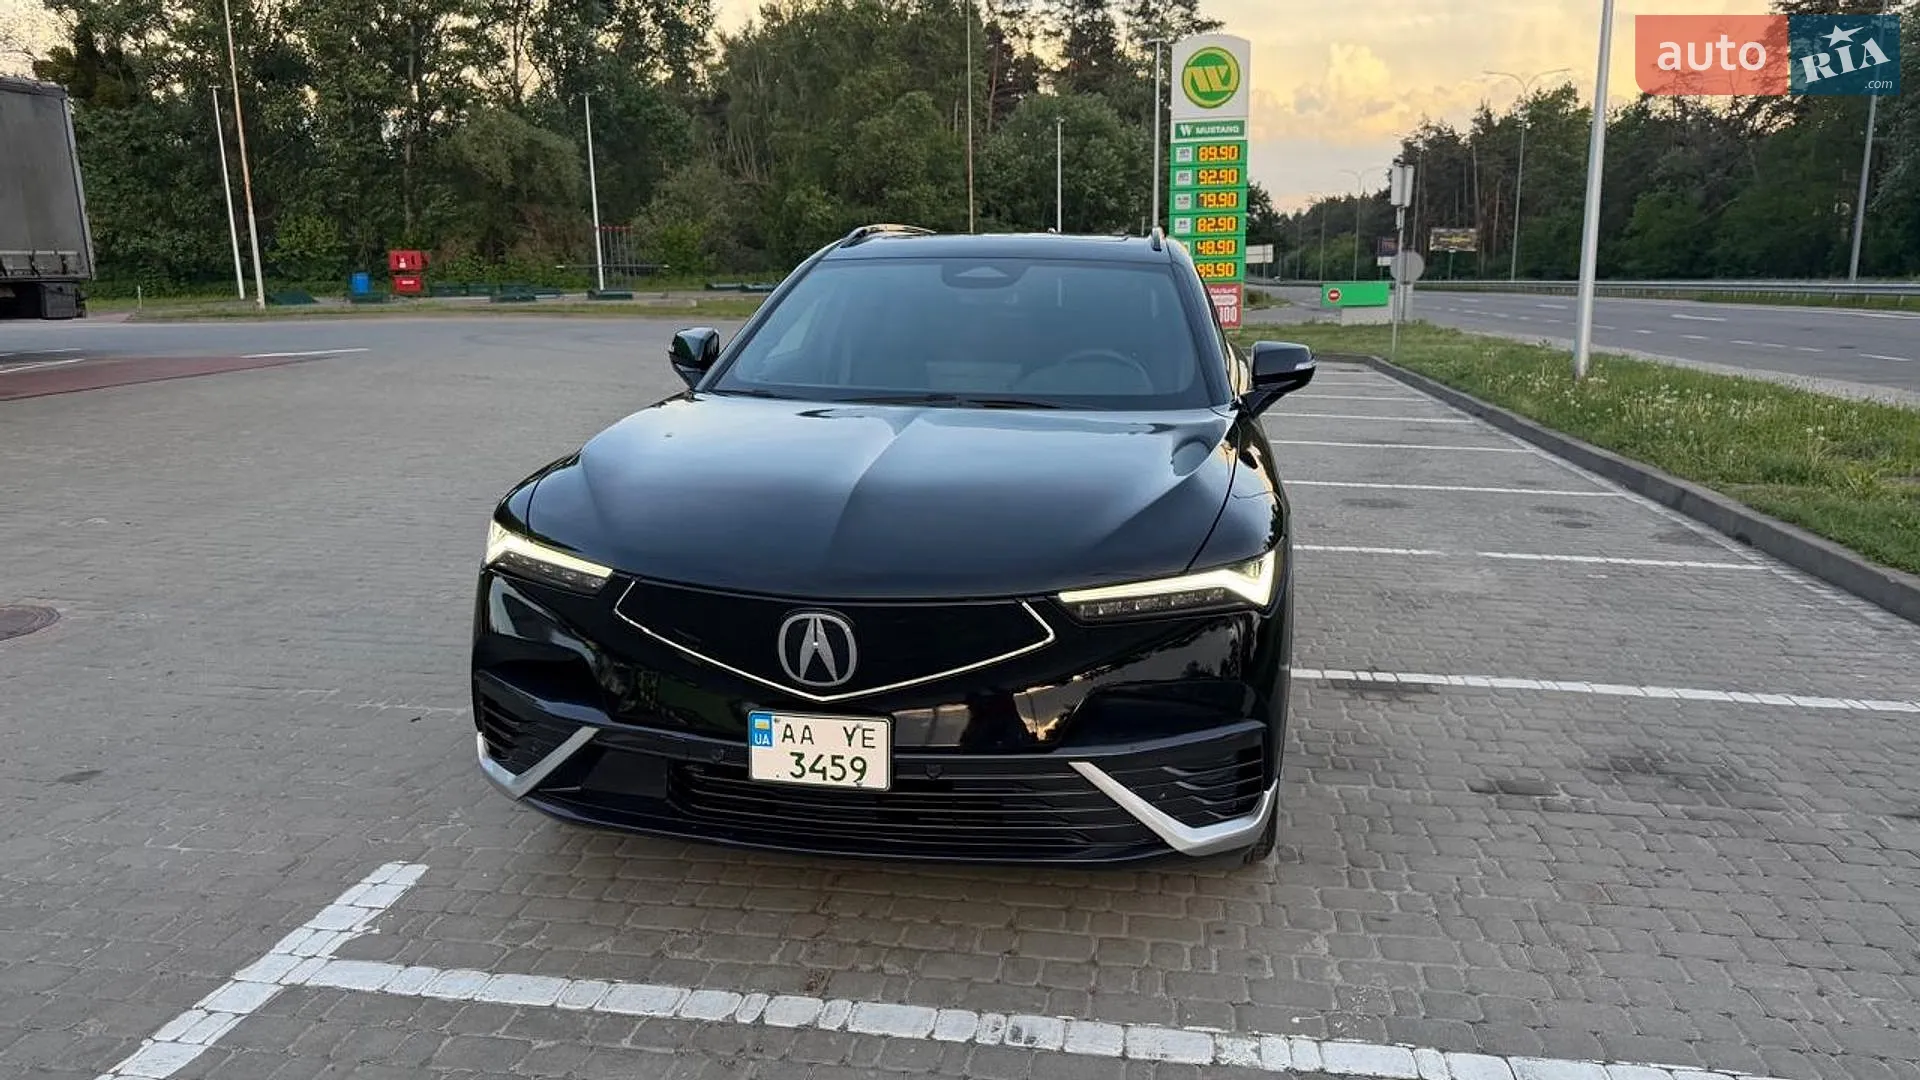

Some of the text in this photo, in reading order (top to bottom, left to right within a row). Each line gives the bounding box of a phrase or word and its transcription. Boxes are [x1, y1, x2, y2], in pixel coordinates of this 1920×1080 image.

[1195, 125, 1239, 134] MUSTANG
[1198, 145, 1239, 162] 89.90
[1198, 168, 1238, 185] 92.90
[1197, 216, 1237, 233] 82.90
[1196, 240, 1236, 255] 48.90
[754, 734, 771, 746] UA
[781, 723, 876, 749] AA YE
[789, 751, 867, 783] 3459
